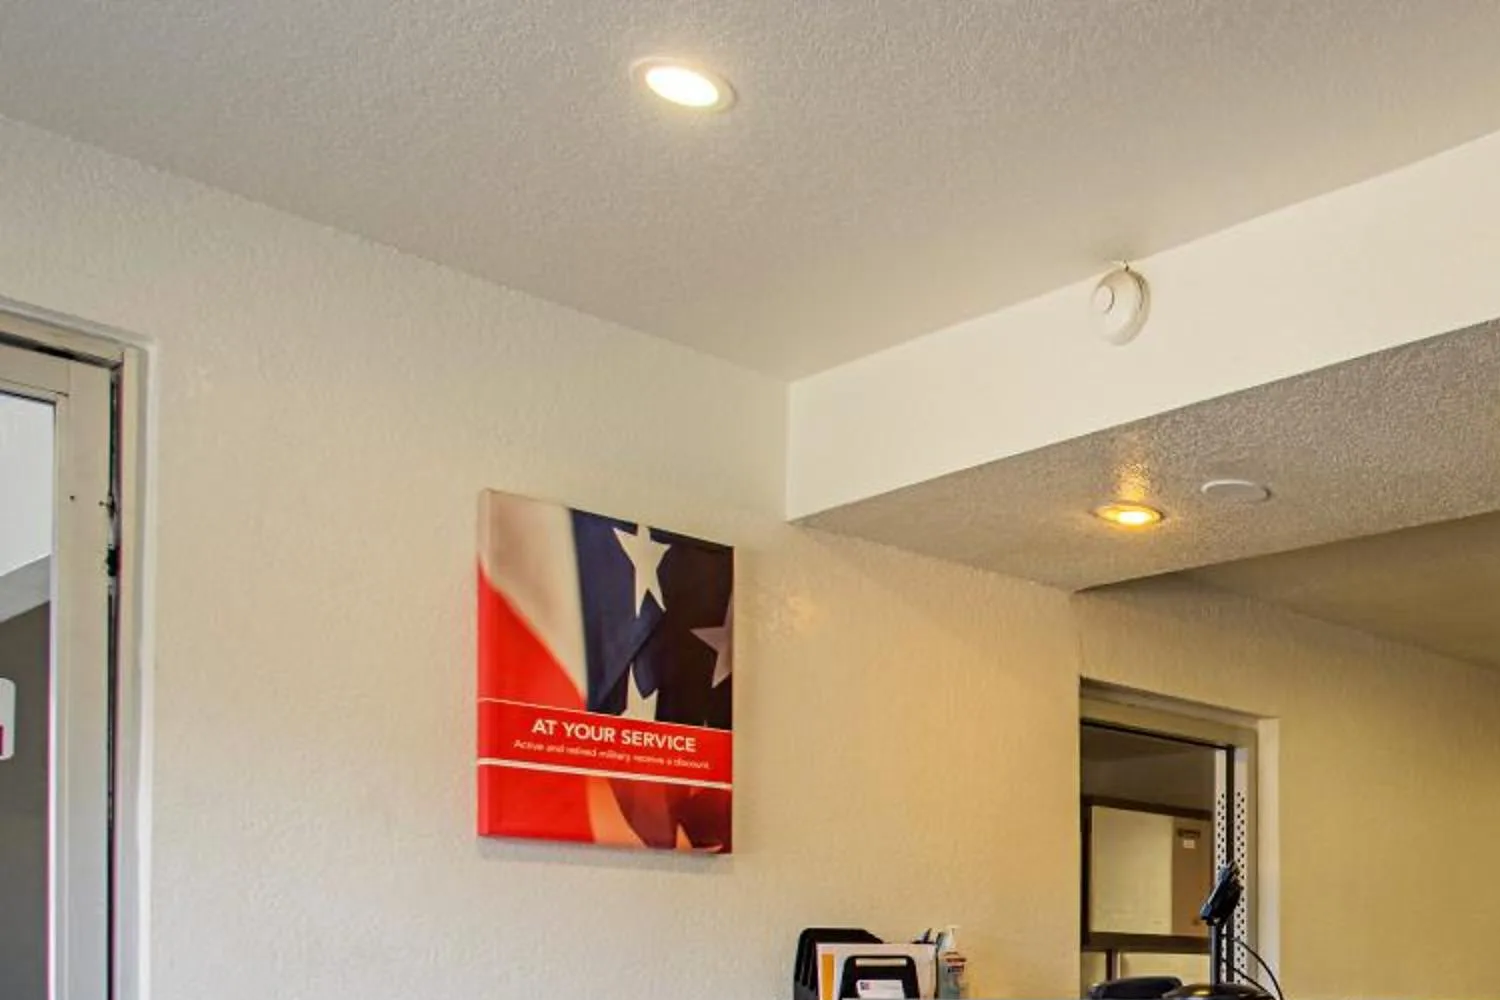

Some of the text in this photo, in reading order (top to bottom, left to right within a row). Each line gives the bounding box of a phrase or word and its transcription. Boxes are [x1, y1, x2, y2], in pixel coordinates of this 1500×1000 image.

[531, 718, 697, 752] AT YOUR SERVICE
